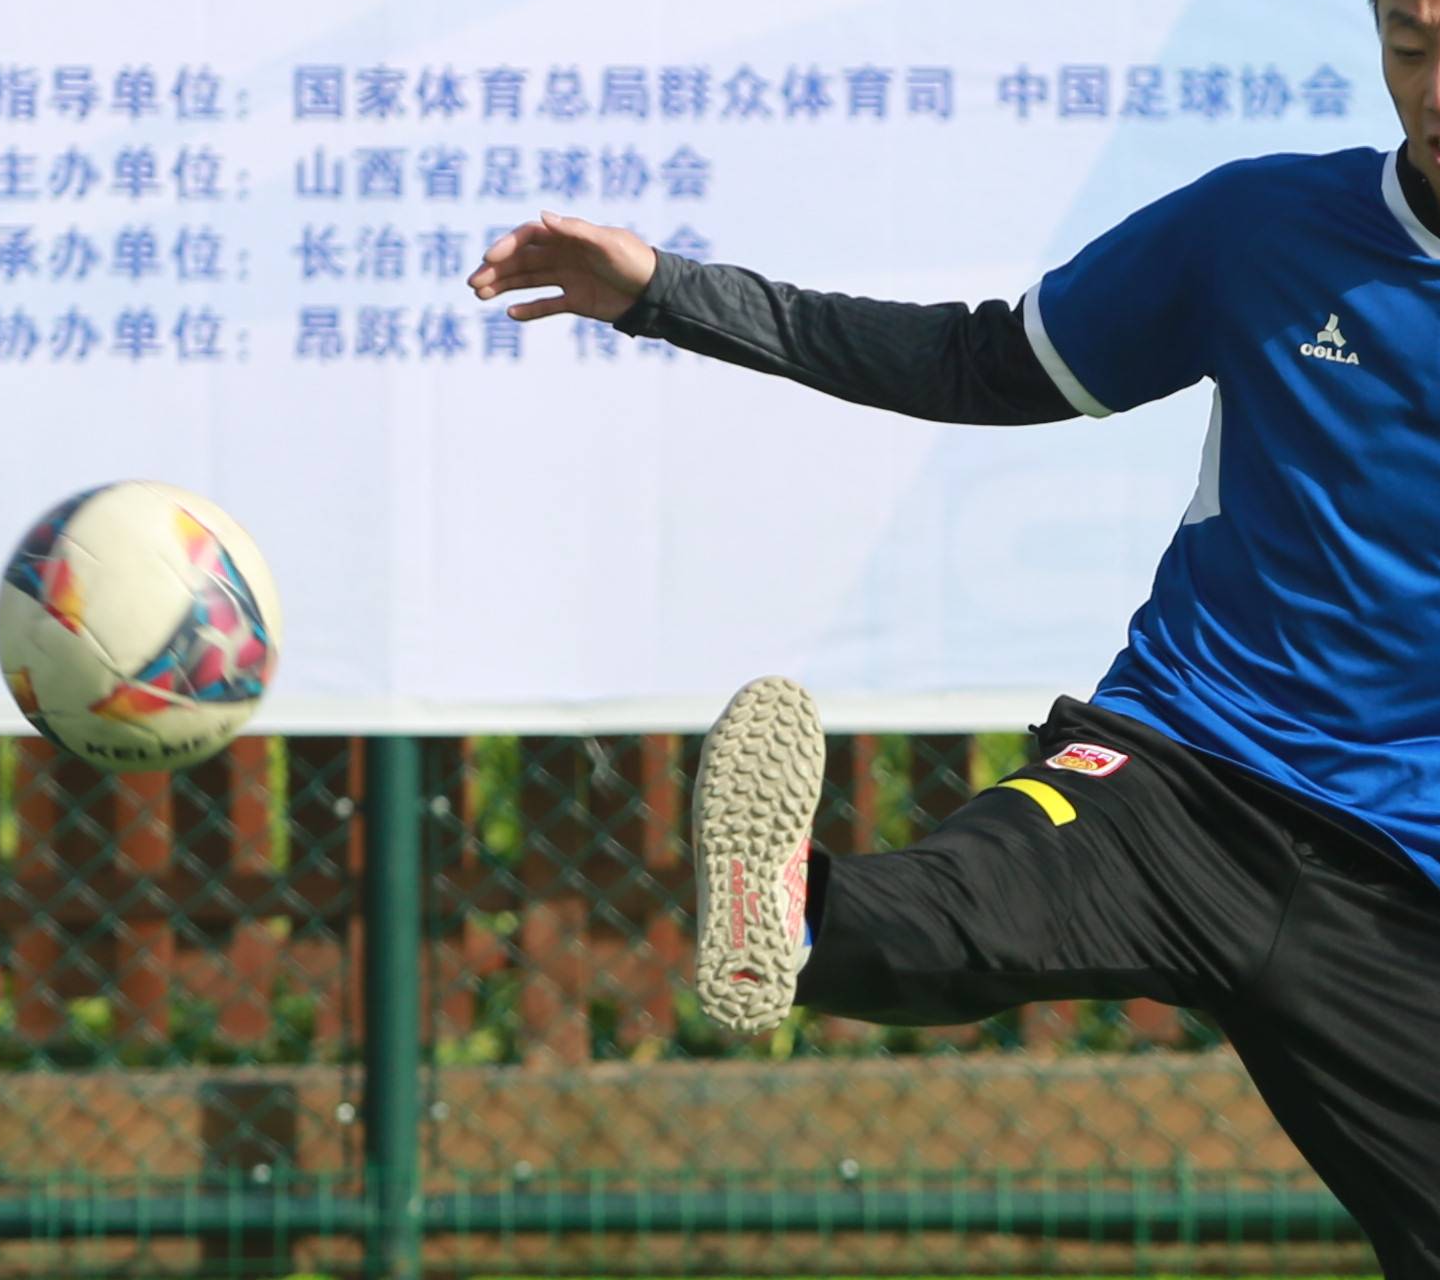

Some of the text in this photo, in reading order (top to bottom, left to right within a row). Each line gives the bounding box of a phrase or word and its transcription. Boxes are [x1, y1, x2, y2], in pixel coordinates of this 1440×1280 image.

[998, 63, 1353, 119] 中国足球协会
